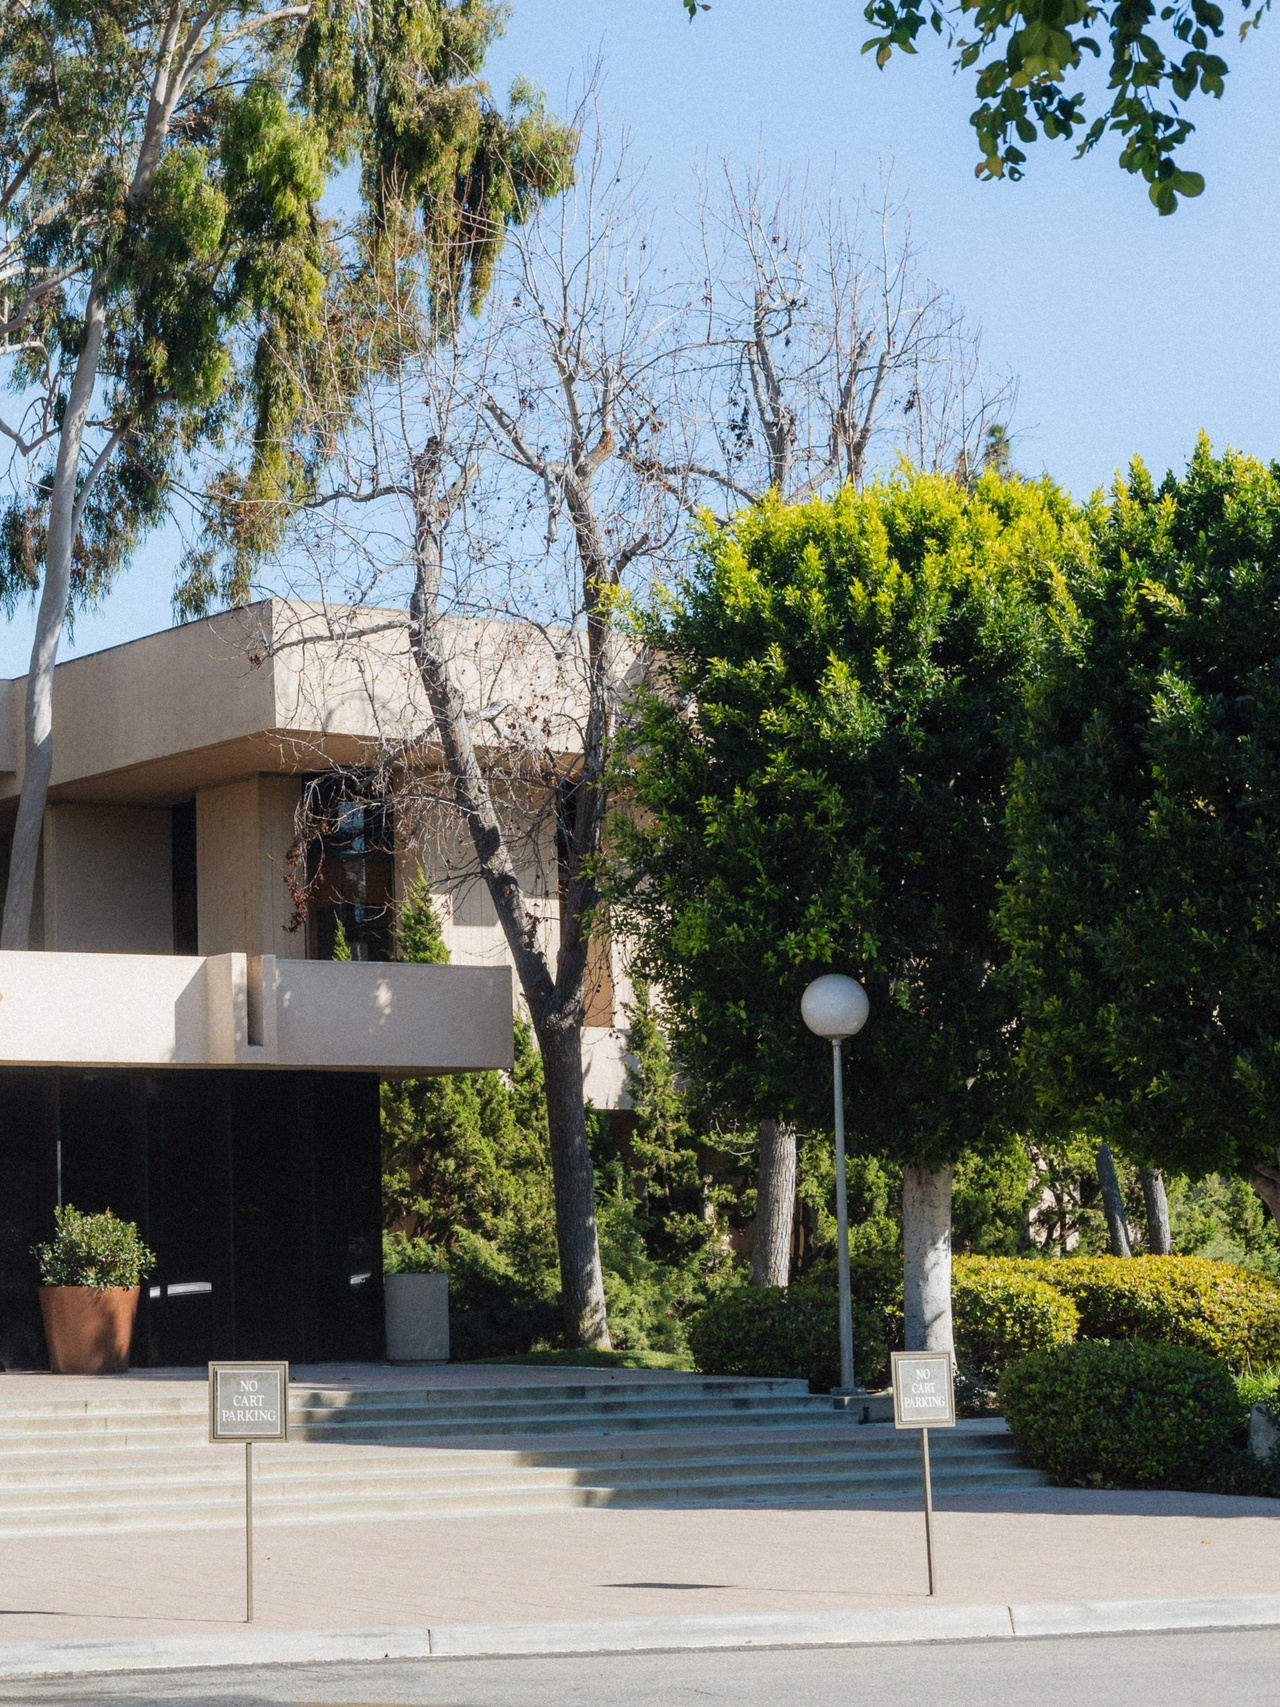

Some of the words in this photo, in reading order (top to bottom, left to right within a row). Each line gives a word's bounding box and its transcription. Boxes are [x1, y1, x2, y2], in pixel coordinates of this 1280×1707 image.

[916, 1368, 931, 1380] NO
[240, 1380, 258, 1392] NO
[911, 1382, 936, 1394] CART
[233, 1395, 265, 1407] CART
[904, 1395, 945, 1408] PARKING
[222, 1409, 276, 1421] PARKING
